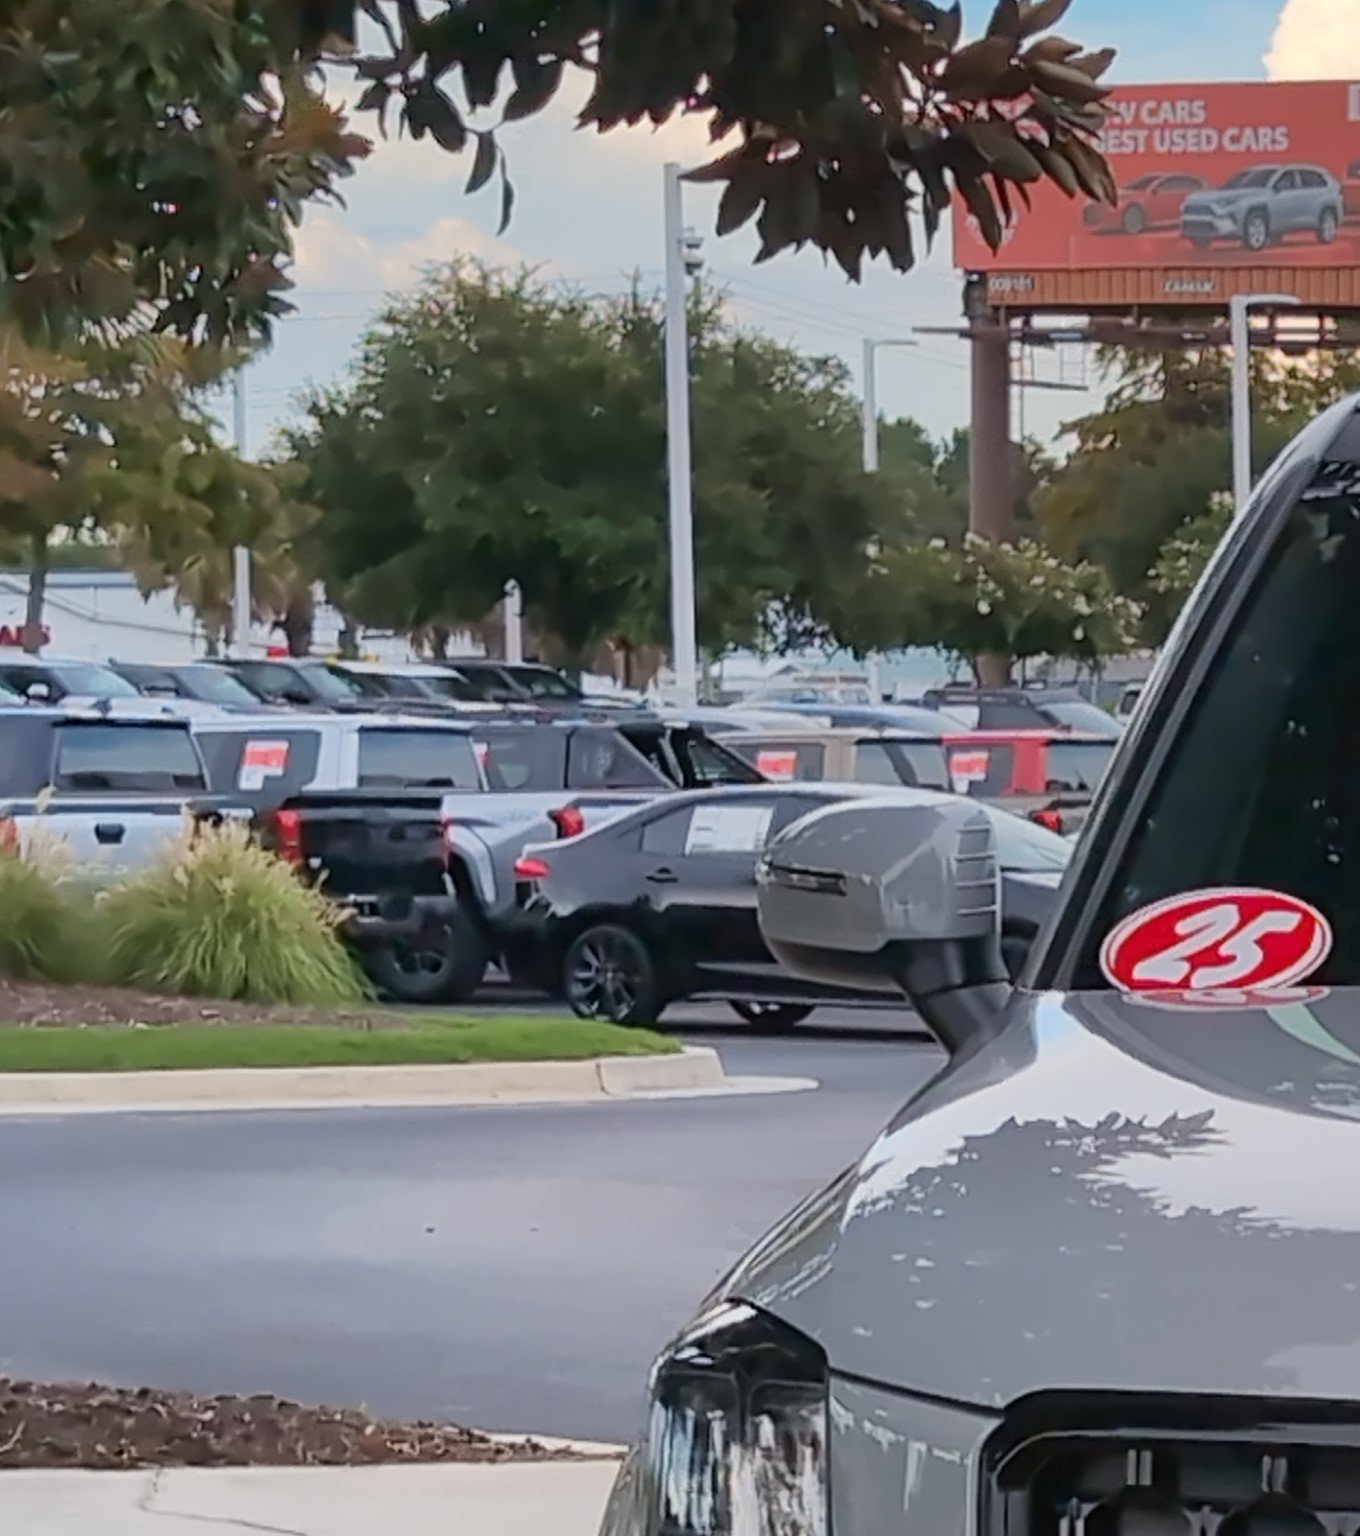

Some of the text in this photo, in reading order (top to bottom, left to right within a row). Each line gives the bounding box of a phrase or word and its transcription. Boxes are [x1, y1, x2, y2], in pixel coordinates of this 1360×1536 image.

[1140, 99, 1206, 125] CARS
[1153, 126, 1219, 153] USED
[1222, 126, 1289, 152] CARS
[1131, 903, 1303, 989] 25
